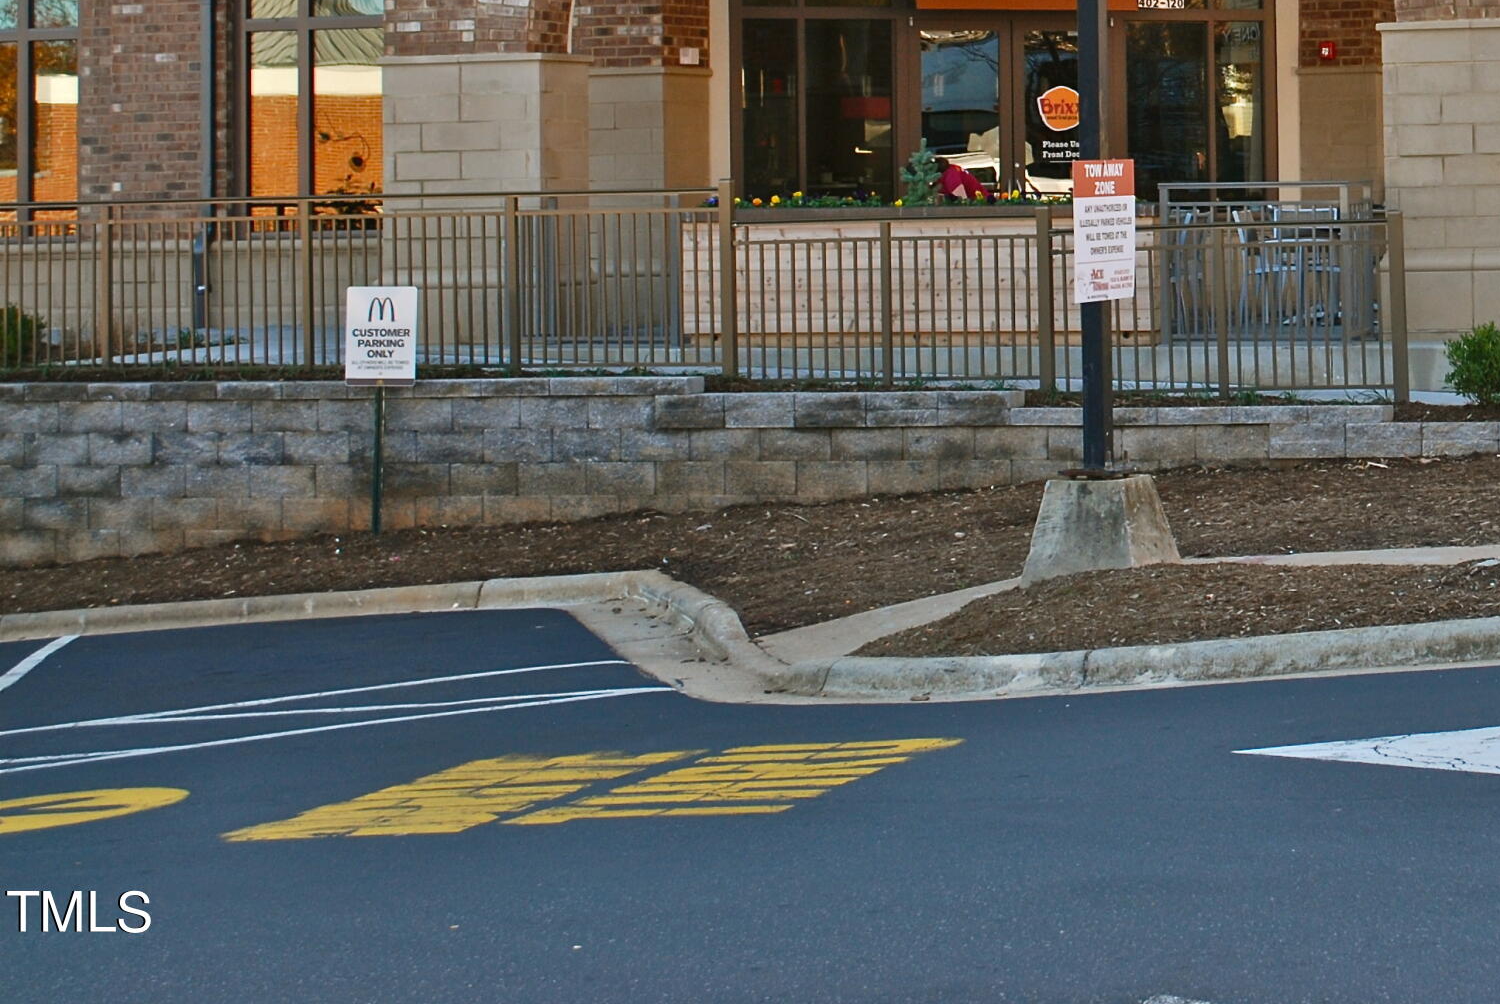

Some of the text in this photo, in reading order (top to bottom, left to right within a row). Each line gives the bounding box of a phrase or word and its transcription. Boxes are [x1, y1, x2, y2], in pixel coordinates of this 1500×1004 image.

[1084, 162, 1124, 178] TOW AWAY
[1095, 181, 1115, 195] ZONE
[352, 328, 410, 337] CUSTOMER
[358, 339, 404, 348] PARKING
[367, 350, 394, 358] ONLY
